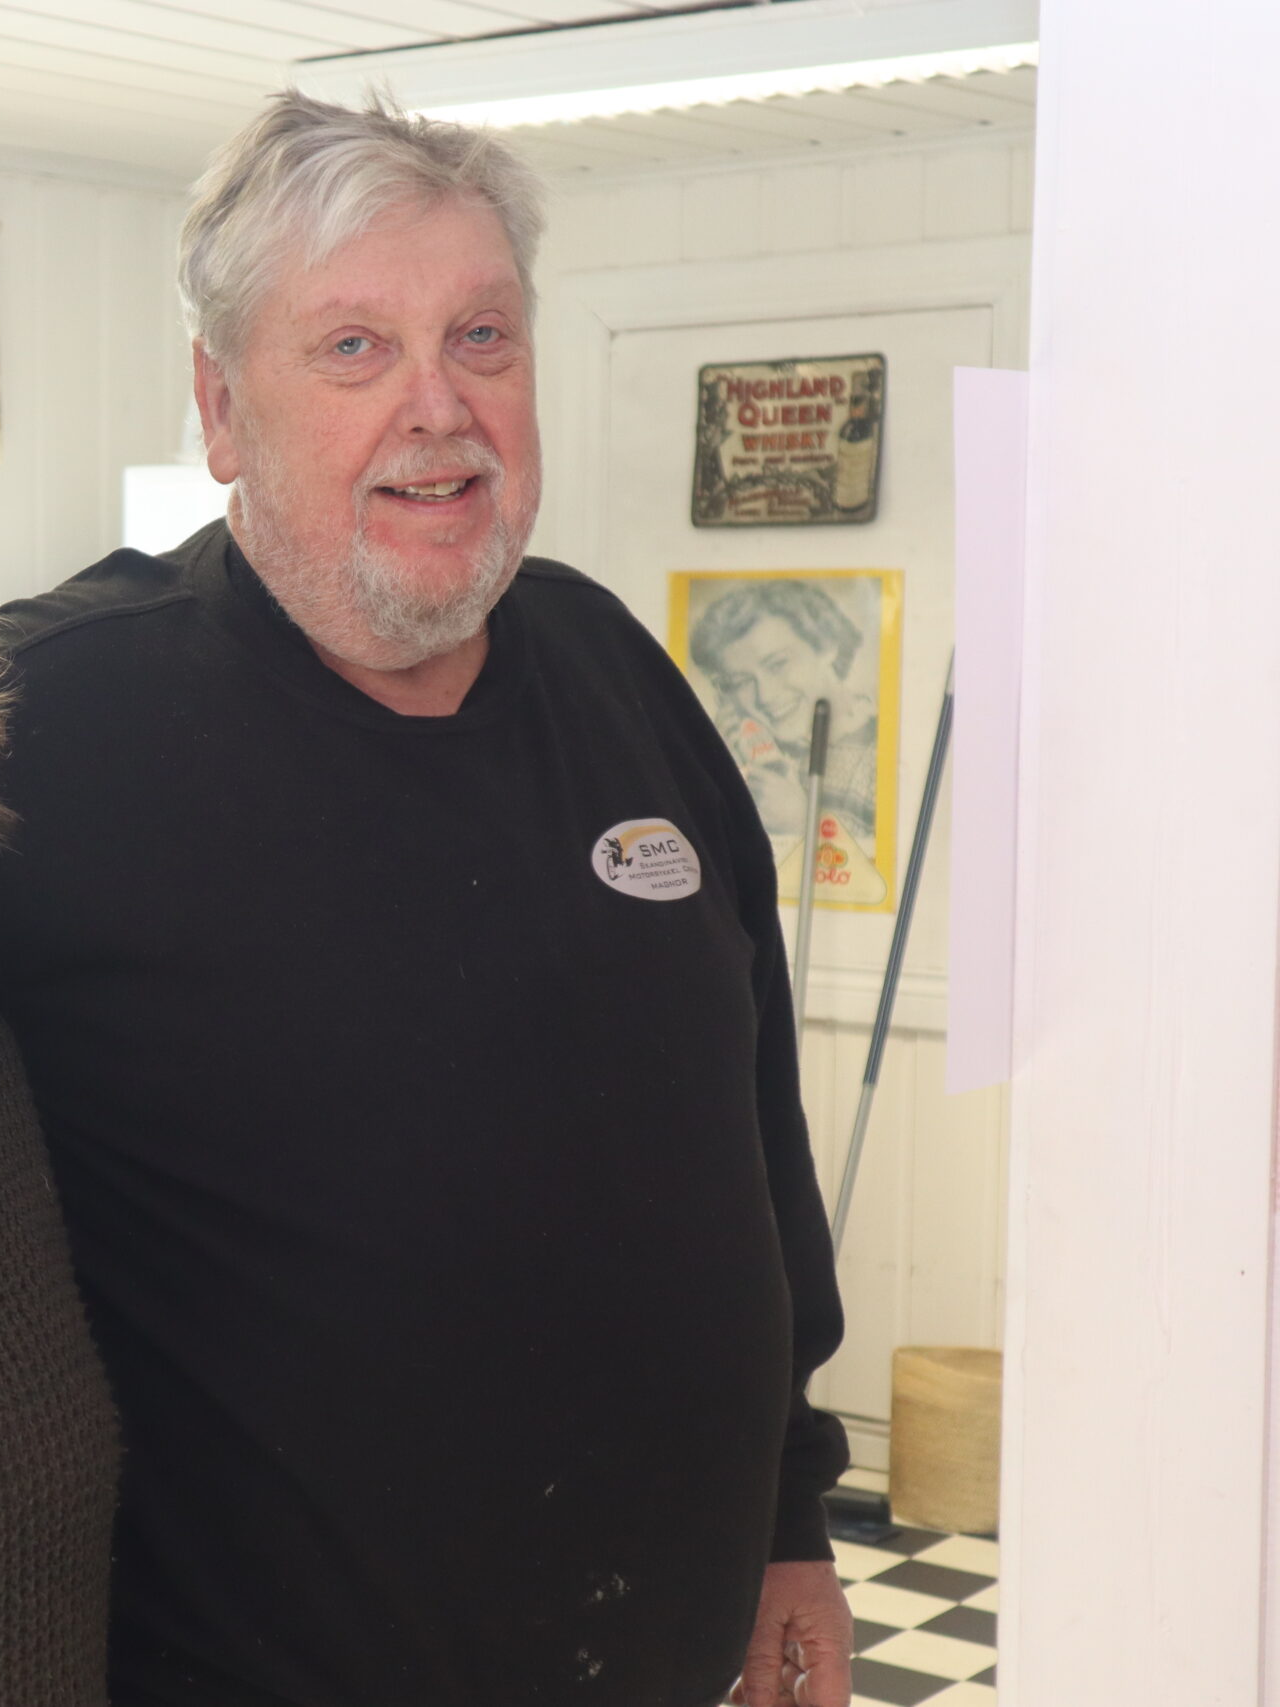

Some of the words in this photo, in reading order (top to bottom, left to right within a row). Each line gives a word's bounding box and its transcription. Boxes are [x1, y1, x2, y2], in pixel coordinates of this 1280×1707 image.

[725, 375, 846, 404] HIGHLAND
[738, 401, 833, 428] QUEEN
[639, 839, 680, 857] SMC
